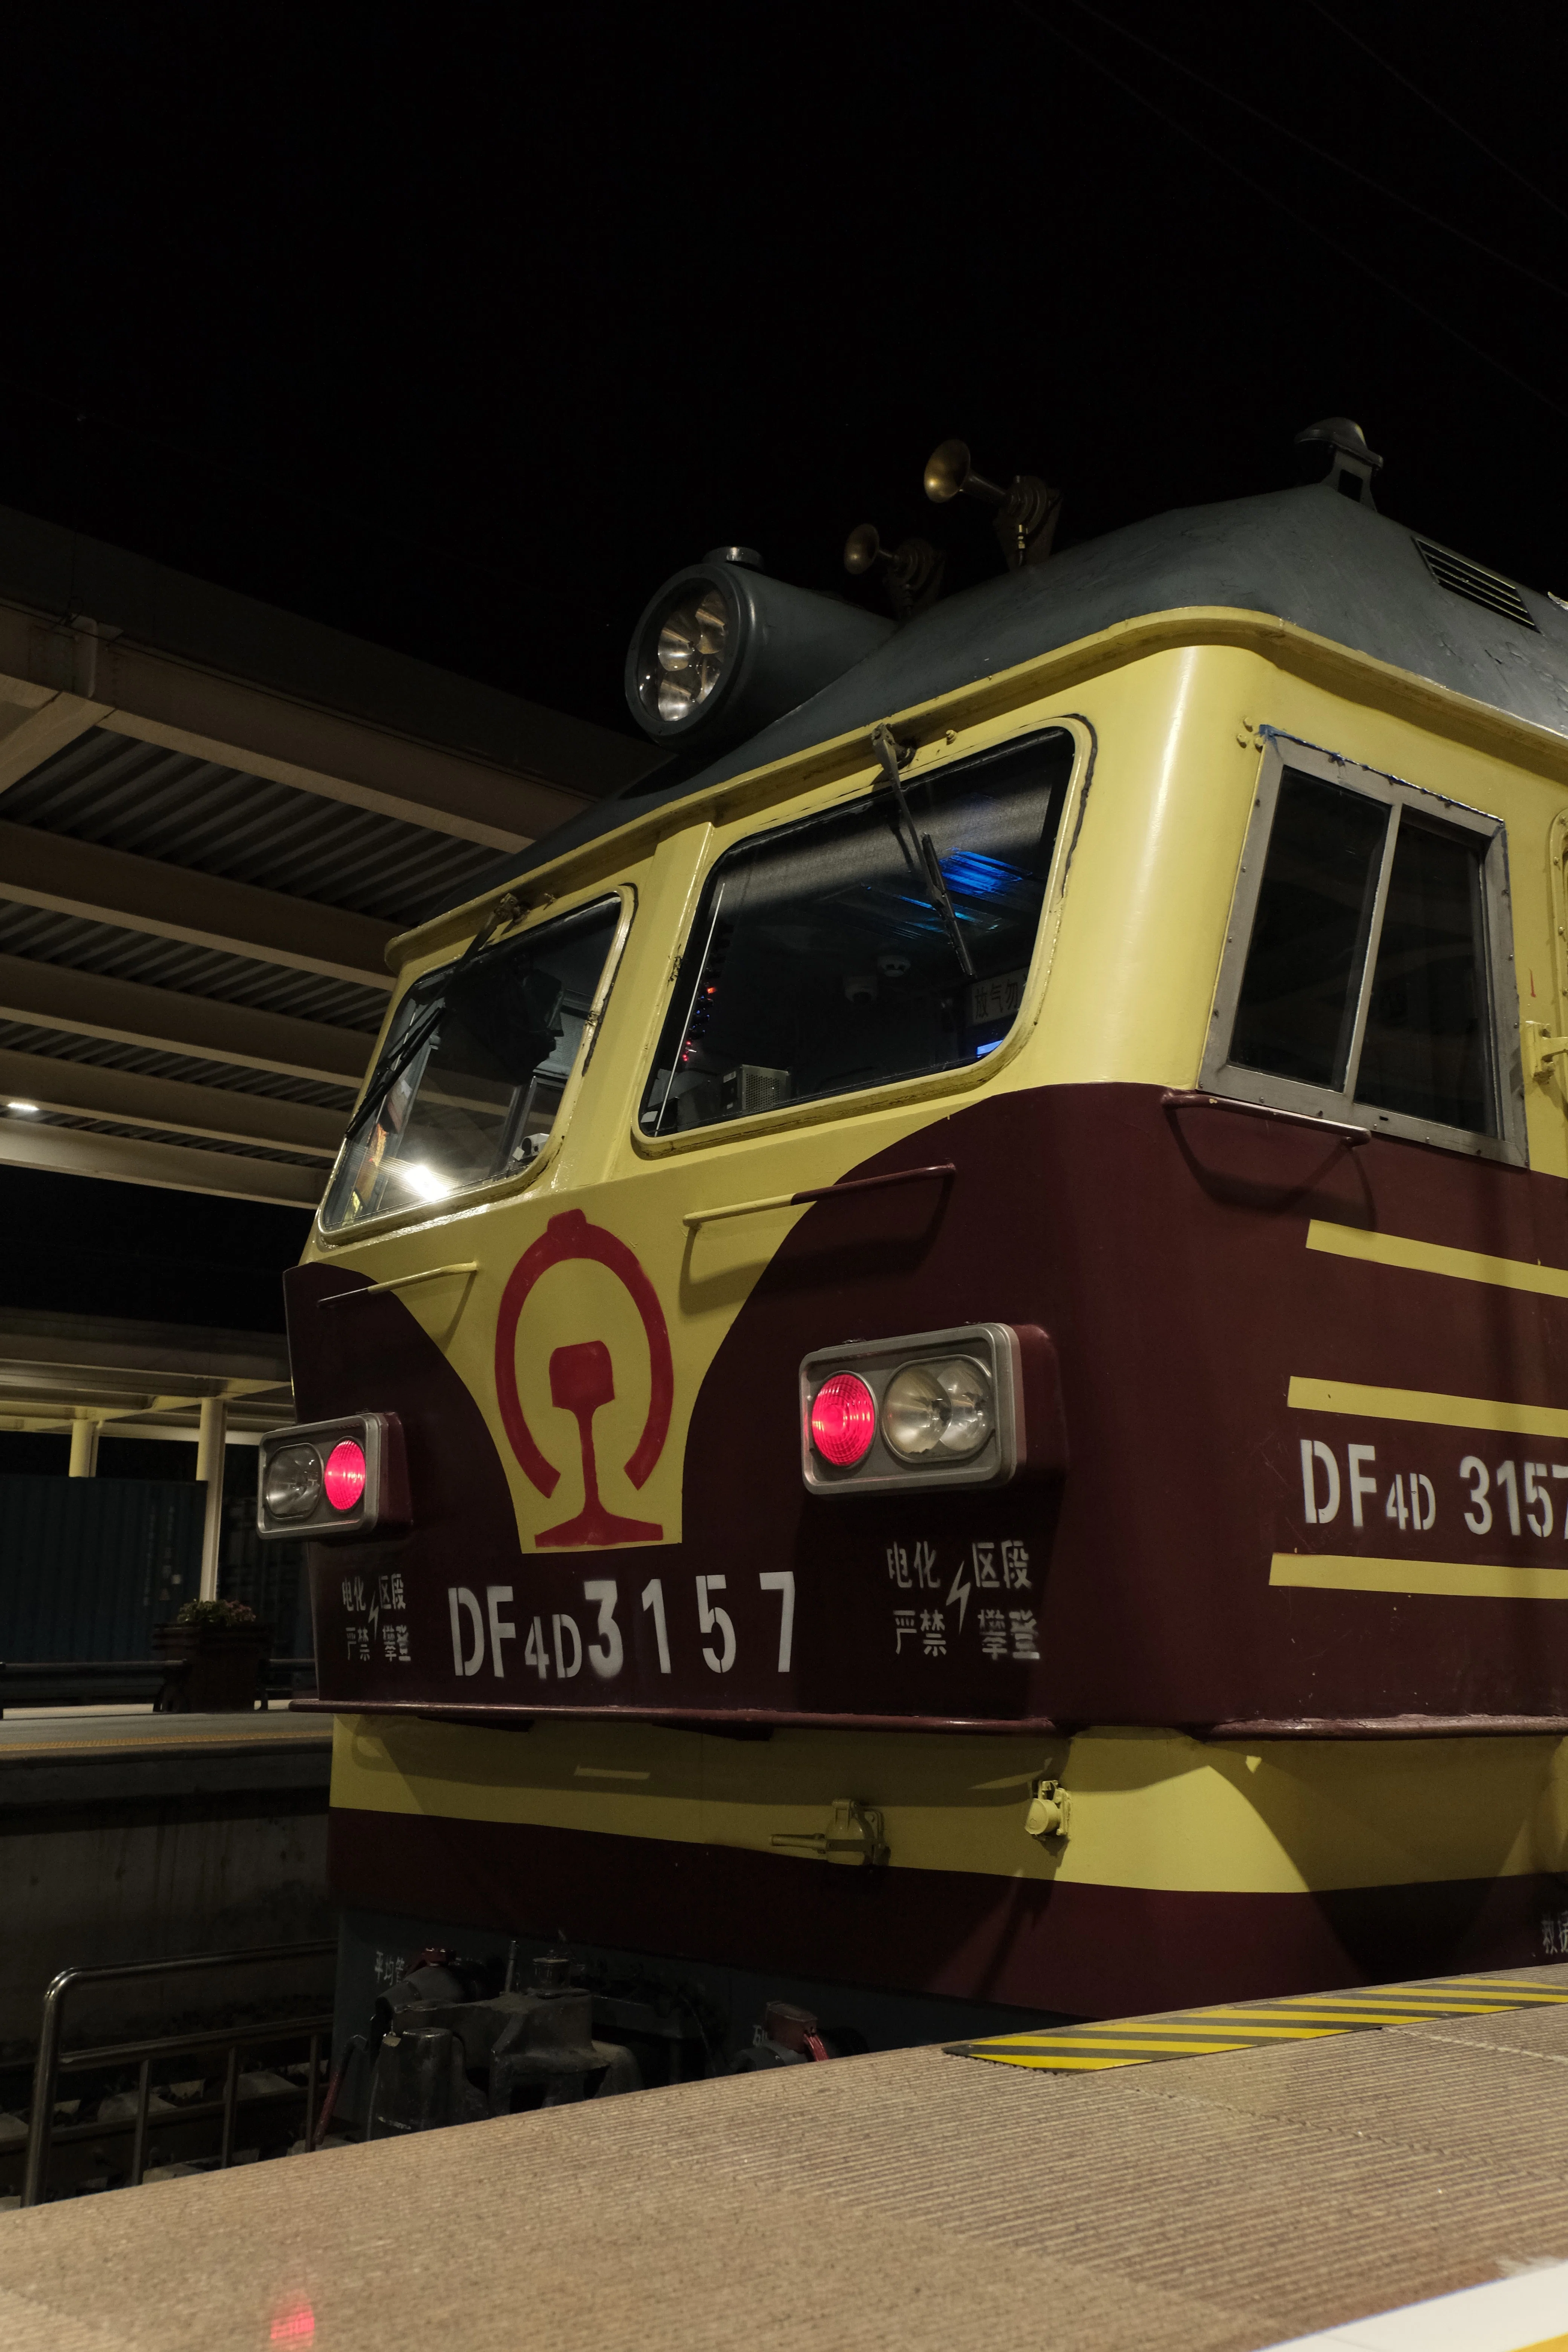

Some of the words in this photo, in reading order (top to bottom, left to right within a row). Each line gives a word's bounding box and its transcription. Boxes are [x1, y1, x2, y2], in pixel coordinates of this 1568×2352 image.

[975, 974, 1027, 1019] 放气勿
[1300, 1439, 1436, 1531] DF4D
